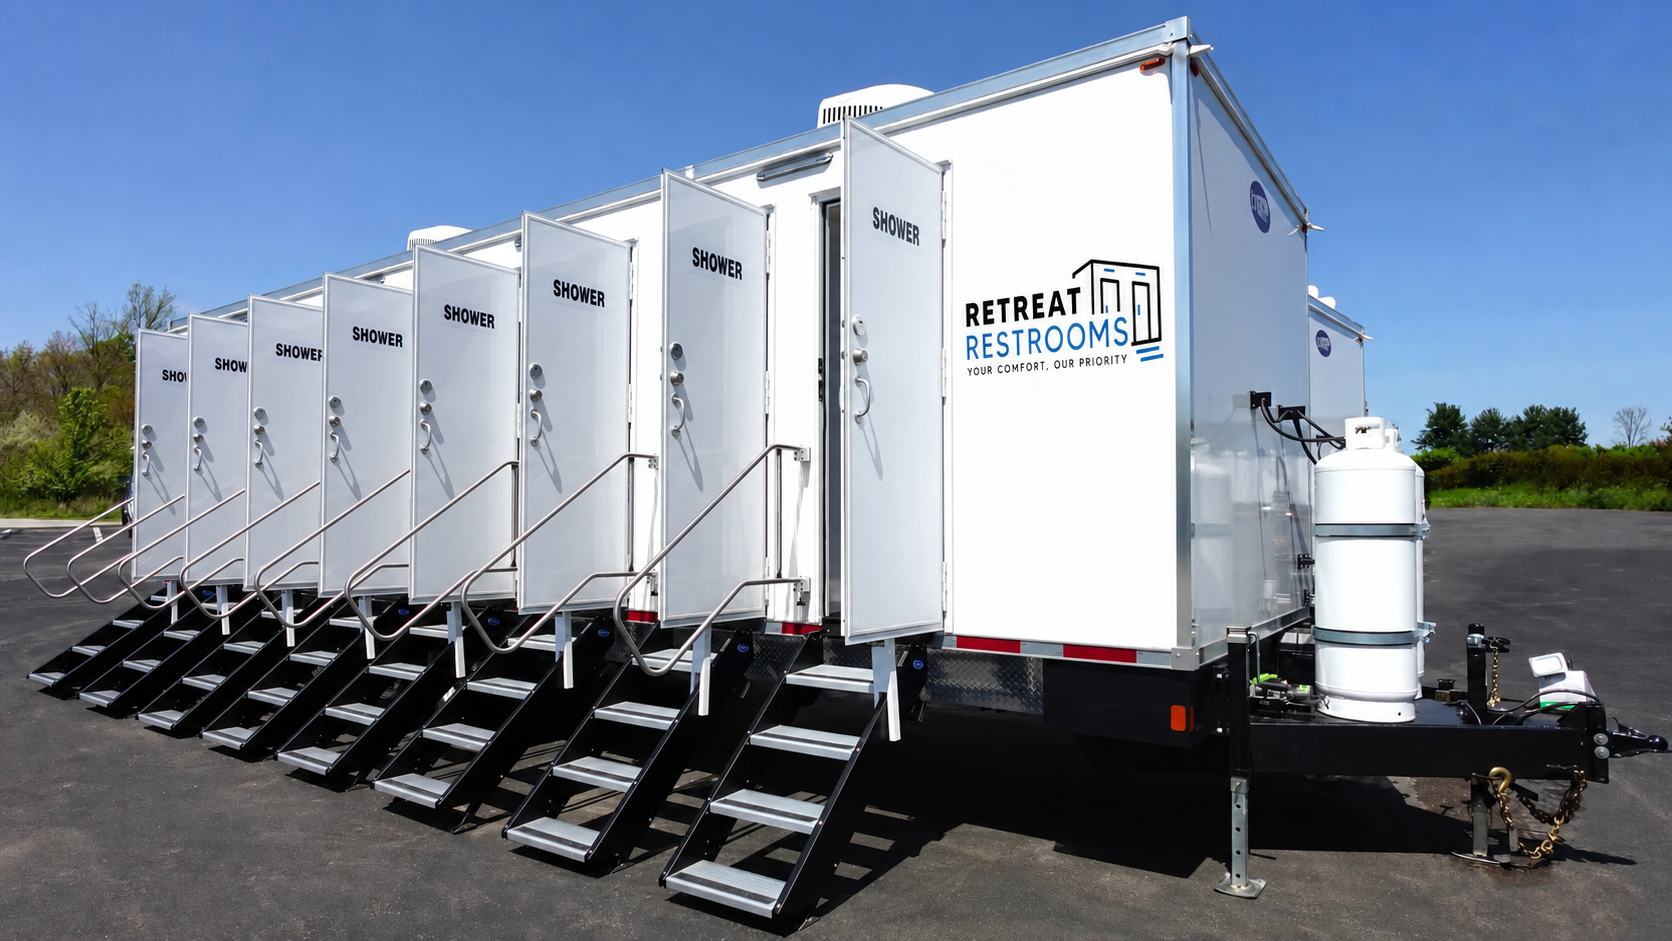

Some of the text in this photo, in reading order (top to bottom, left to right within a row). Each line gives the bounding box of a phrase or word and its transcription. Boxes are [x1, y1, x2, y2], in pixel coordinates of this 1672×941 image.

[872, 206, 920, 247] SHOWER
[691, 246, 743, 281] SHOWER
[553, 278, 605, 308] SHOWER
[965, 286, 1081, 328] RETREAT
[443, 303, 495, 330] SHOWER
[352, 325, 403, 348] SHOWER
[966, 315, 1129, 361] RESTROOMS
[214, 357, 248, 374] SHOW
[967, 365, 993, 377] YOUR
[1053, 358, 1075, 370] OUR
[1079, 354, 1128, 368] PRIORITY
